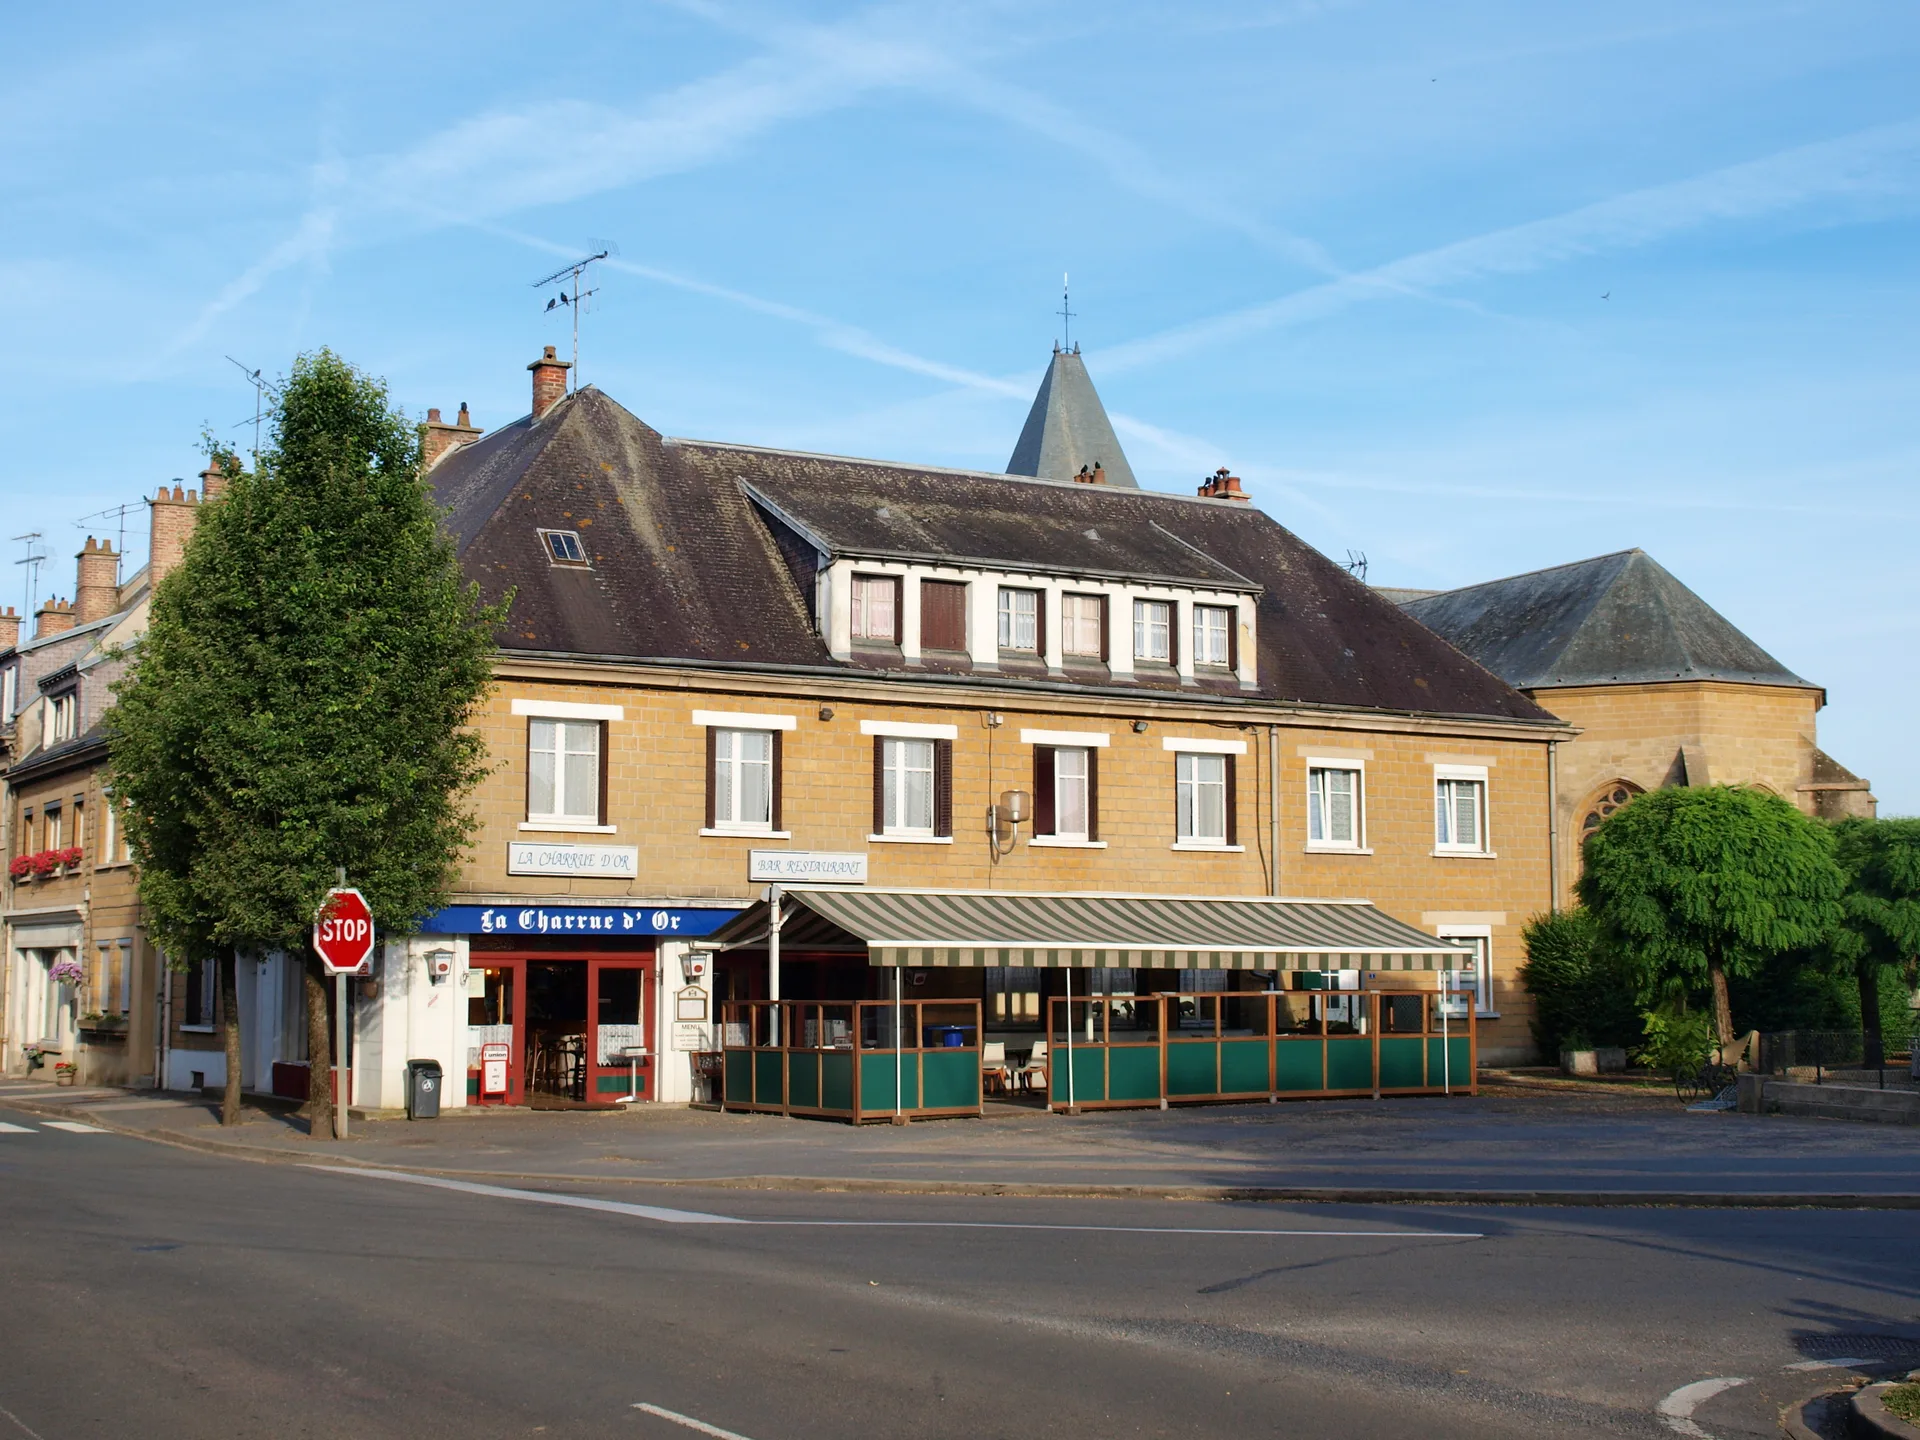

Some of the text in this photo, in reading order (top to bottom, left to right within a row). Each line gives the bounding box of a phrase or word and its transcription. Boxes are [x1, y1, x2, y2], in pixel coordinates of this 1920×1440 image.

[517, 850, 631, 871] LA CHARRUE D'OR
[758, 860, 861, 875] BAR RESTAURANT
[322, 919, 367, 942] STOP
[481, 909, 508, 933] La
[518, 909, 615, 934] Charrue
